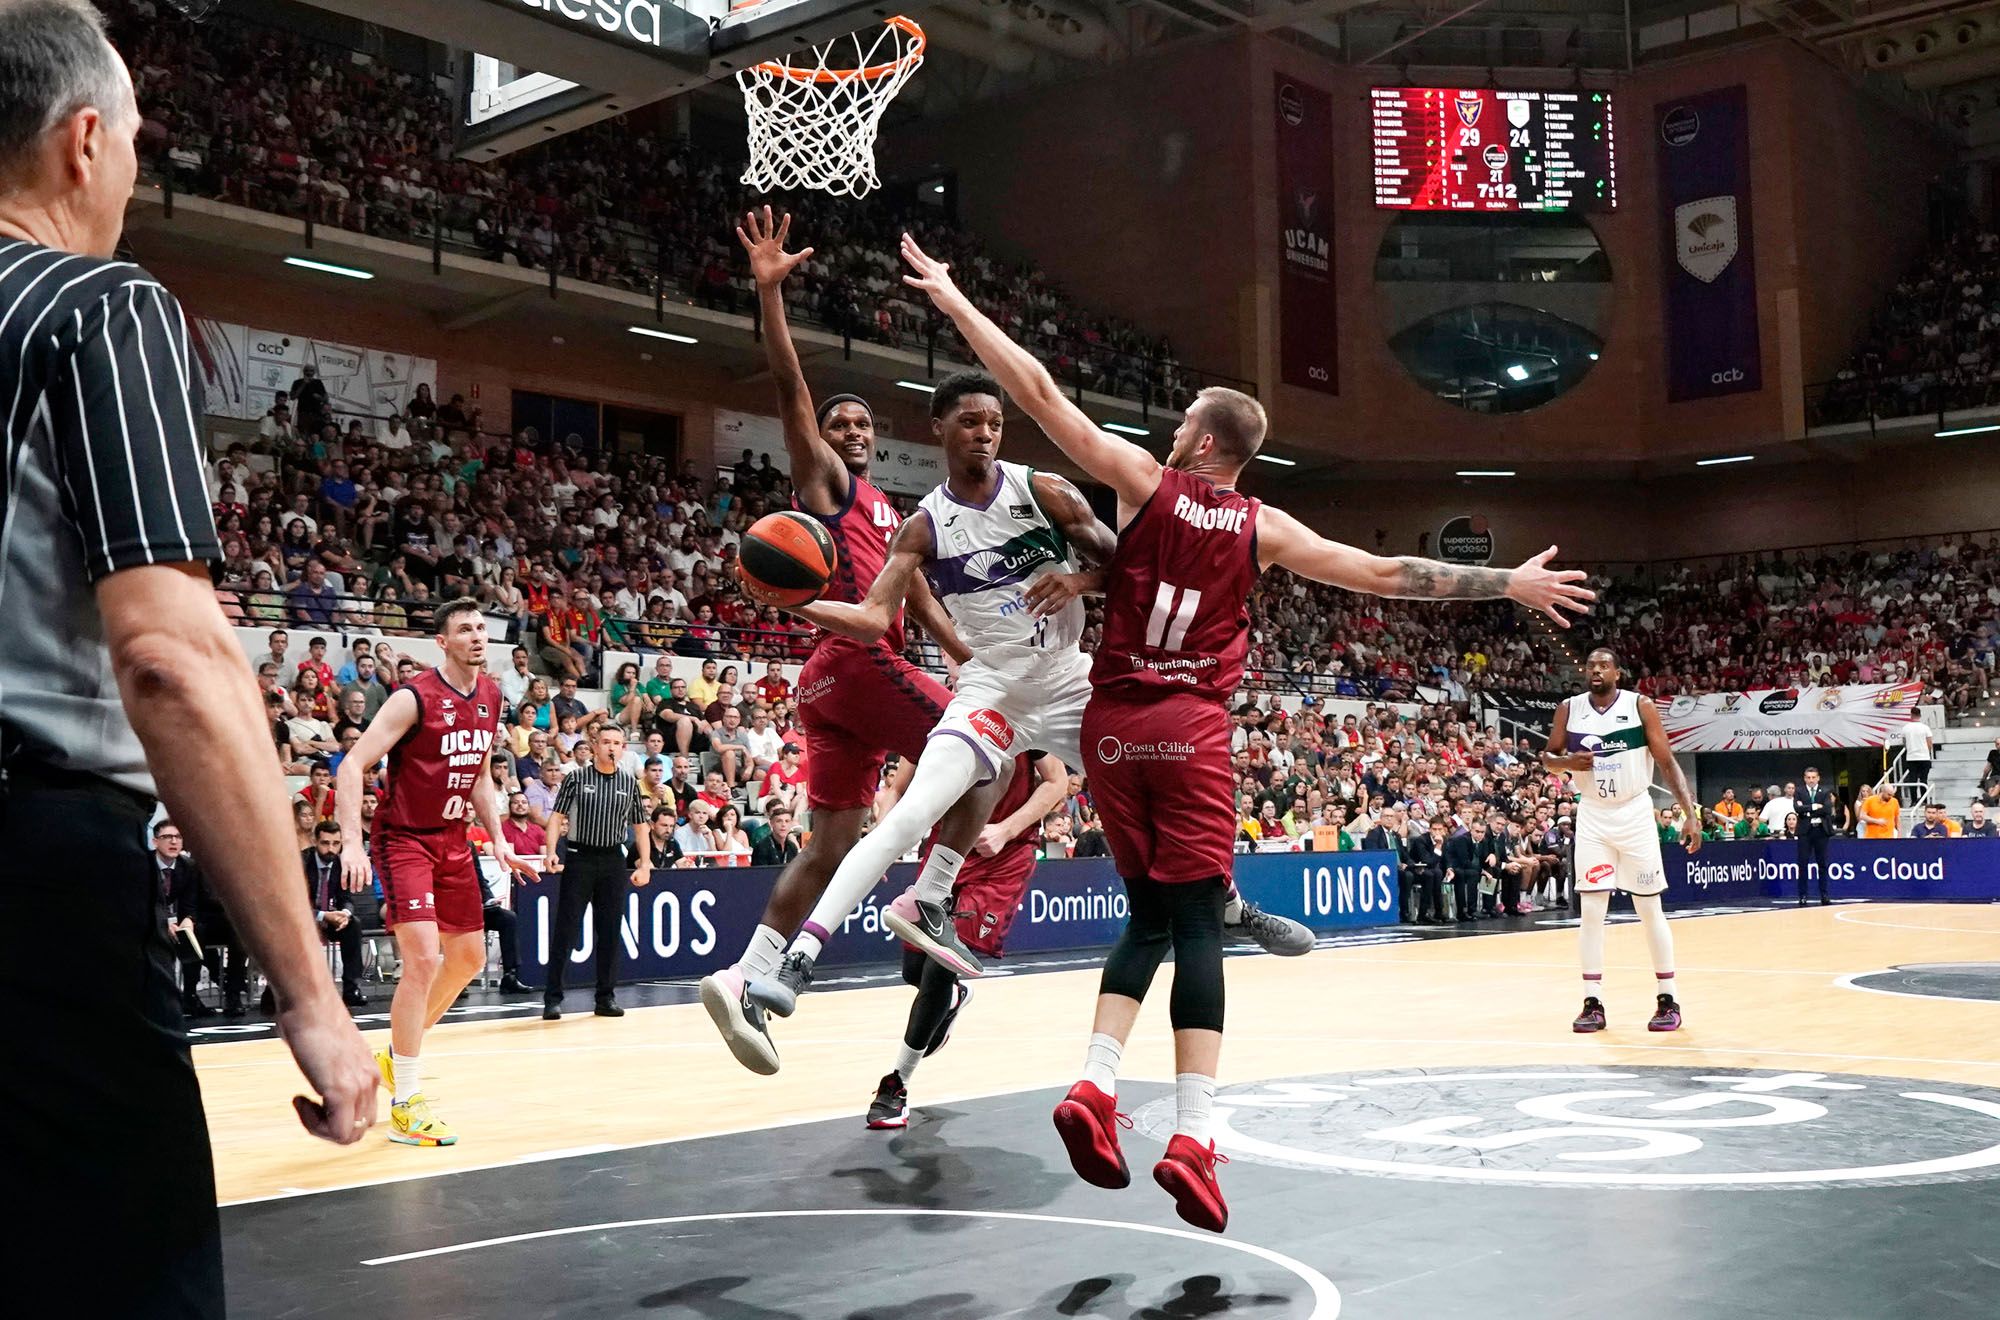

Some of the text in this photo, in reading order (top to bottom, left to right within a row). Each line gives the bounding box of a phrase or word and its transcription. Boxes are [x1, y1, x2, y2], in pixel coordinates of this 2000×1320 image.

[1460, 128, 1480, 147] 29
[1510, 129, 1530, 148] 24
[1456, 171, 1462, 185] 1
[1490, 170, 1503, 183] 2T
[1530, 172, 1537, 186] 1
[1477, 183, 1517, 199] 7:12
[1285, 229, 1329, 259] UCAM
[1688, 239, 1725, 254] Unicaja
[1286, 248, 1328, 271] UNIVERSIDAD
[257, 340, 285, 356] acb
[1308, 365, 1328, 382] acb
[1711, 367, 1744, 383] acb
[1443, 537, 1488, 545] supercopa
[1447, 544, 1489, 553] endesa
[1145, 580, 1203, 651] 11
[1733, 727, 1821, 738] #SupercopaEndesa
[1123, 741, 1196, 754] Costa Cálida
[1601, 739, 1628, 751] Unicaja
[1161, 753, 1187, 761] Murcia
[1596, 779, 1617, 799] 34
[1686, 856, 1944, 890] Páginas web Domnos Cloud
[1303, 864, 1393, 917] IONOS
